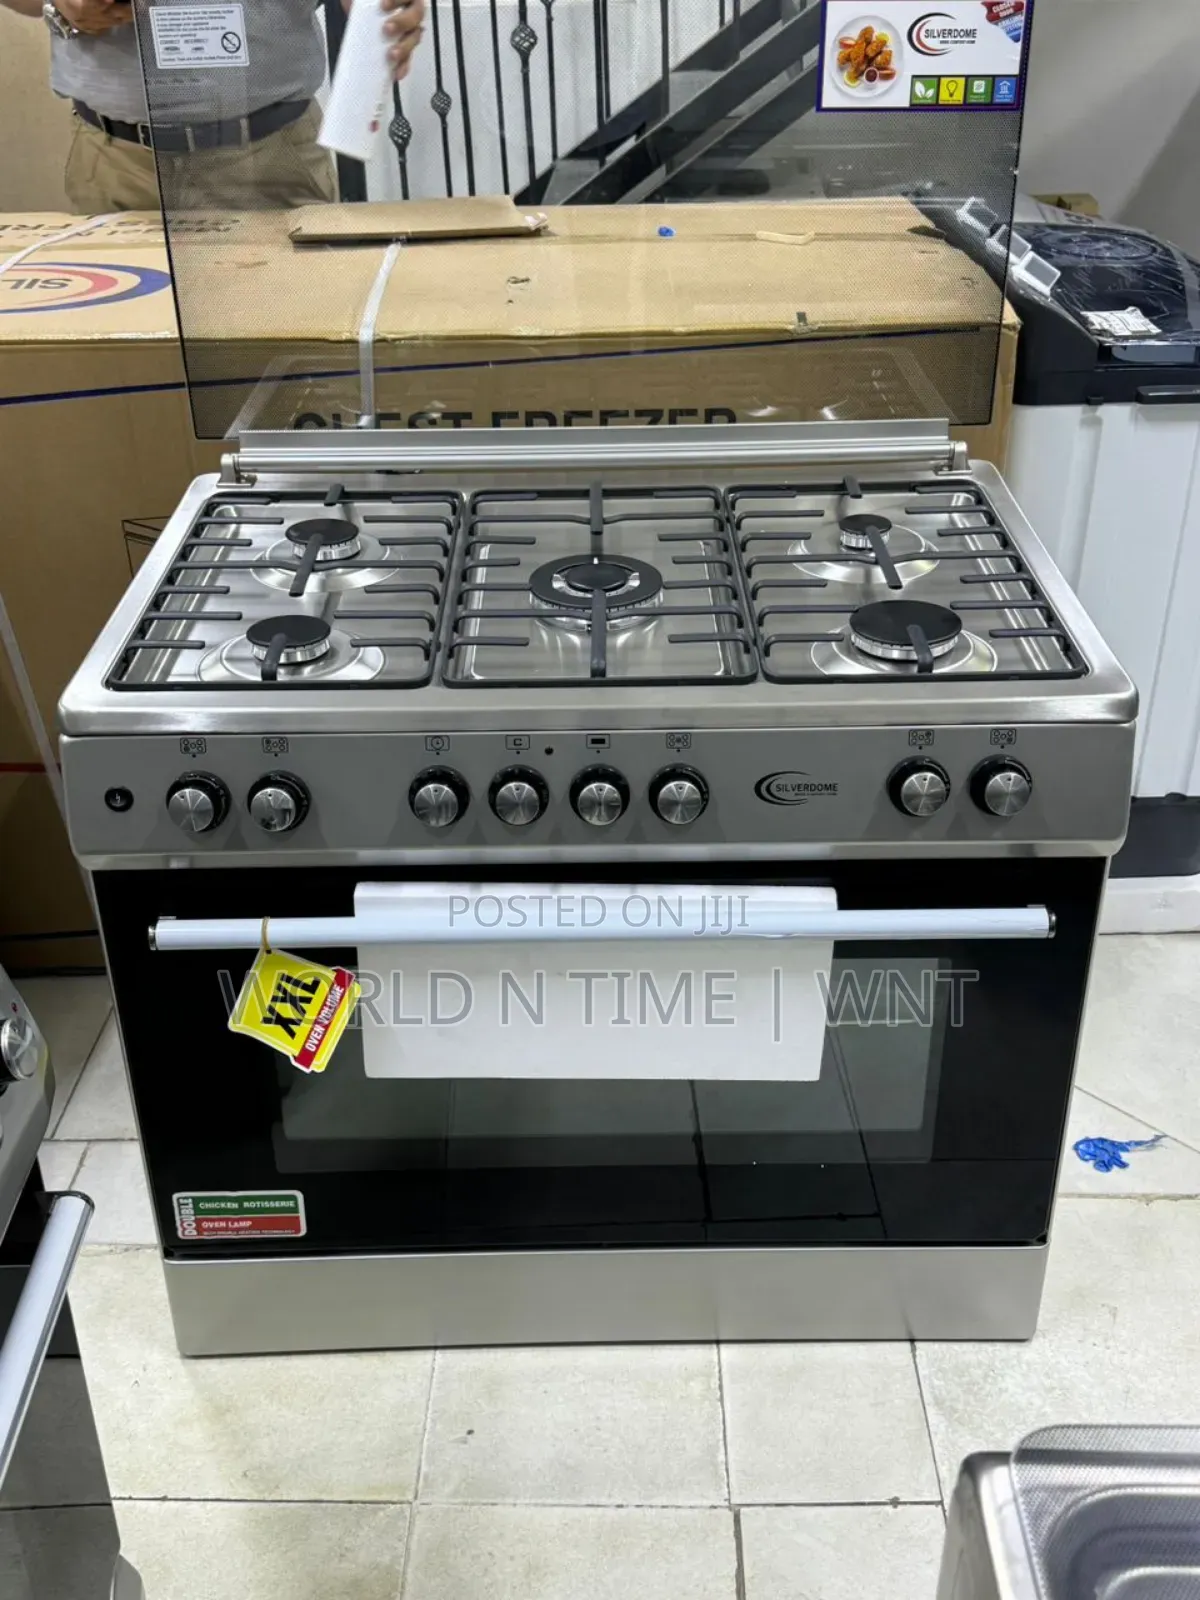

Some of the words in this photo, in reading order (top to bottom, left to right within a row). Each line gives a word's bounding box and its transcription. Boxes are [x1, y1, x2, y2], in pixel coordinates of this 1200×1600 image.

[924, 28, 978, 39] SILVERDOME
[775, 783, 839, 792] SILVERDOME
[260, 973, 321, 1040] XXL
[305, 1026, 326, 1052] OVEN
[318, 984, 345, 1026] VOLUME
[199, 1201, 239, 1209] CHICKEN
[243, 1200, 296, 1208] ROTISSERIE
[179, 1198, 198, 1236] DOUBLE
[201, 1220, 226, 1228] OVEN
[228, 1220, 253, 1228] LAMP
